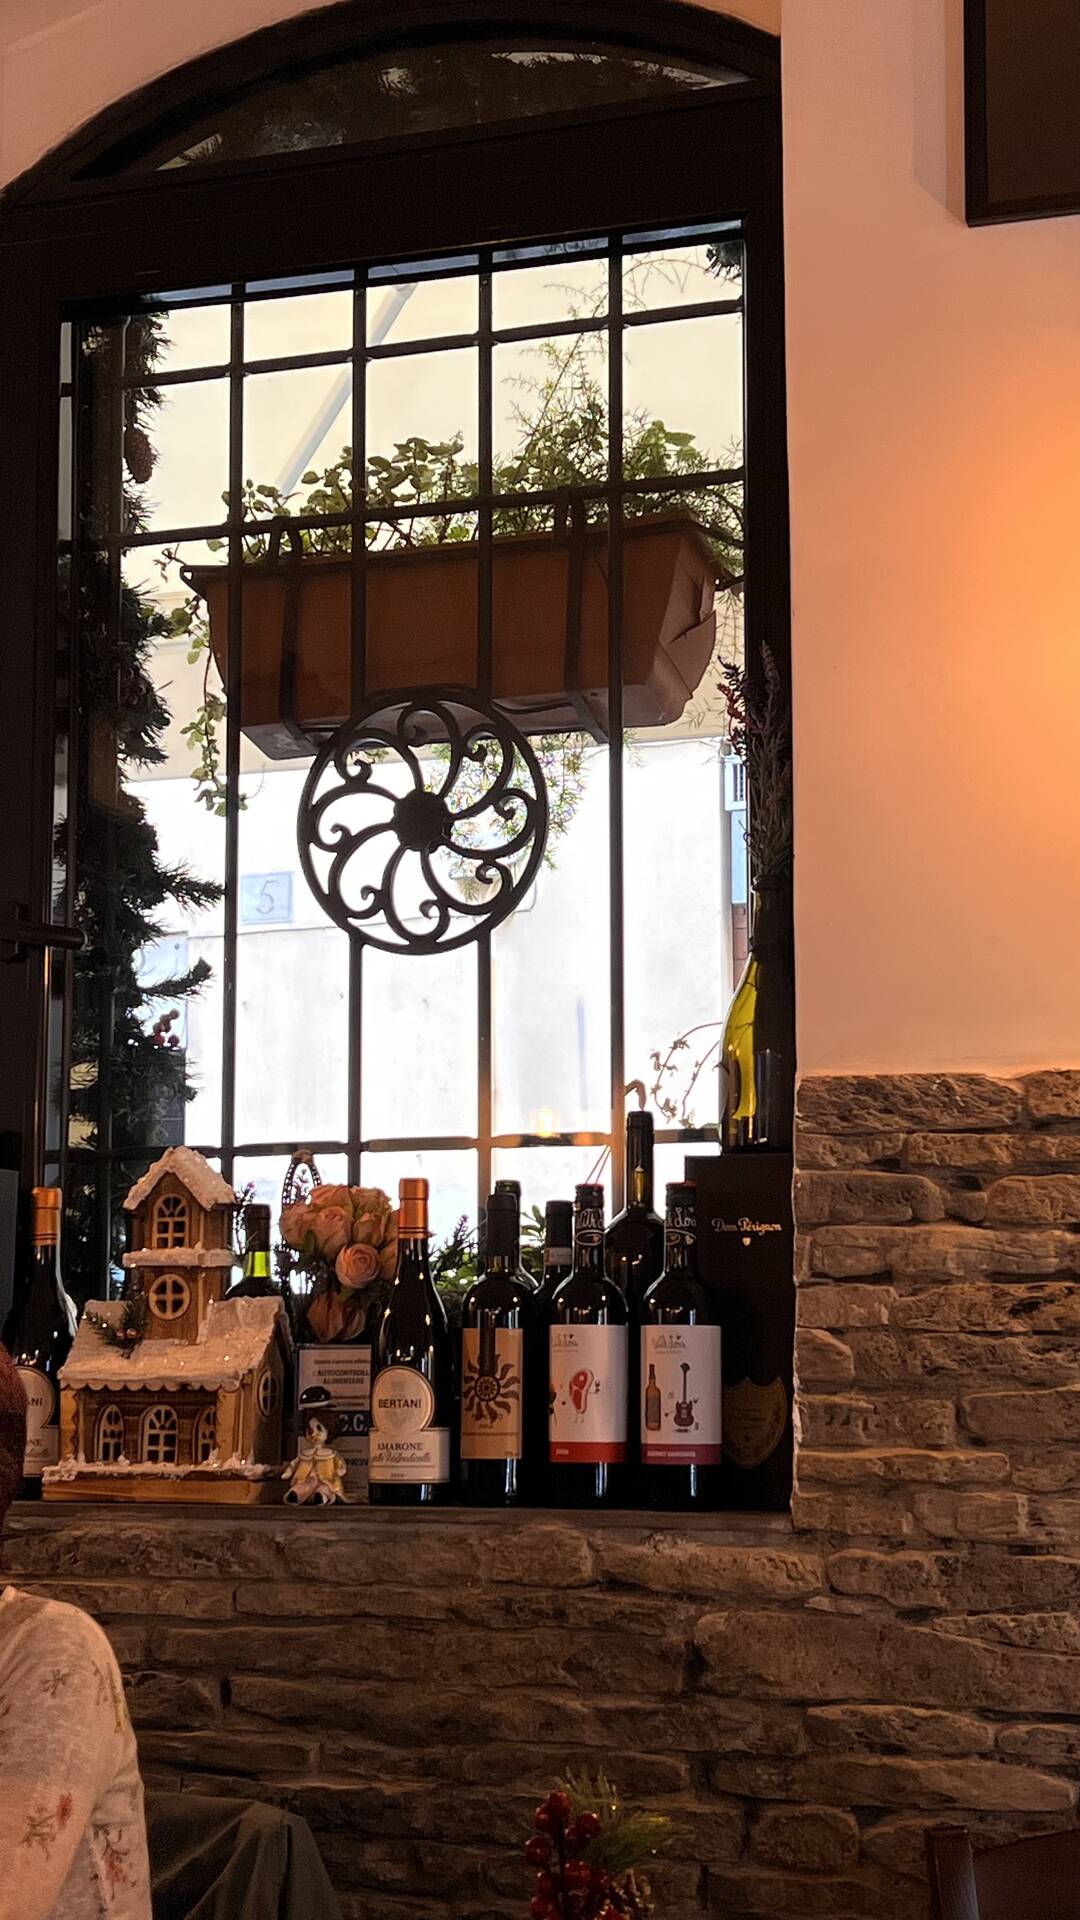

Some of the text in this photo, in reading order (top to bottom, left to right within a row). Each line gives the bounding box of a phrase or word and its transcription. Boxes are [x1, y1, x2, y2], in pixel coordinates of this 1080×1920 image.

[256, 880, 279, 915] 5
[711, 1217, 782, 1236] Dom Pérignon
[378, 1398, 422, 1409] BERTANI
[376, 1442, 424, 1451] AMARONE
